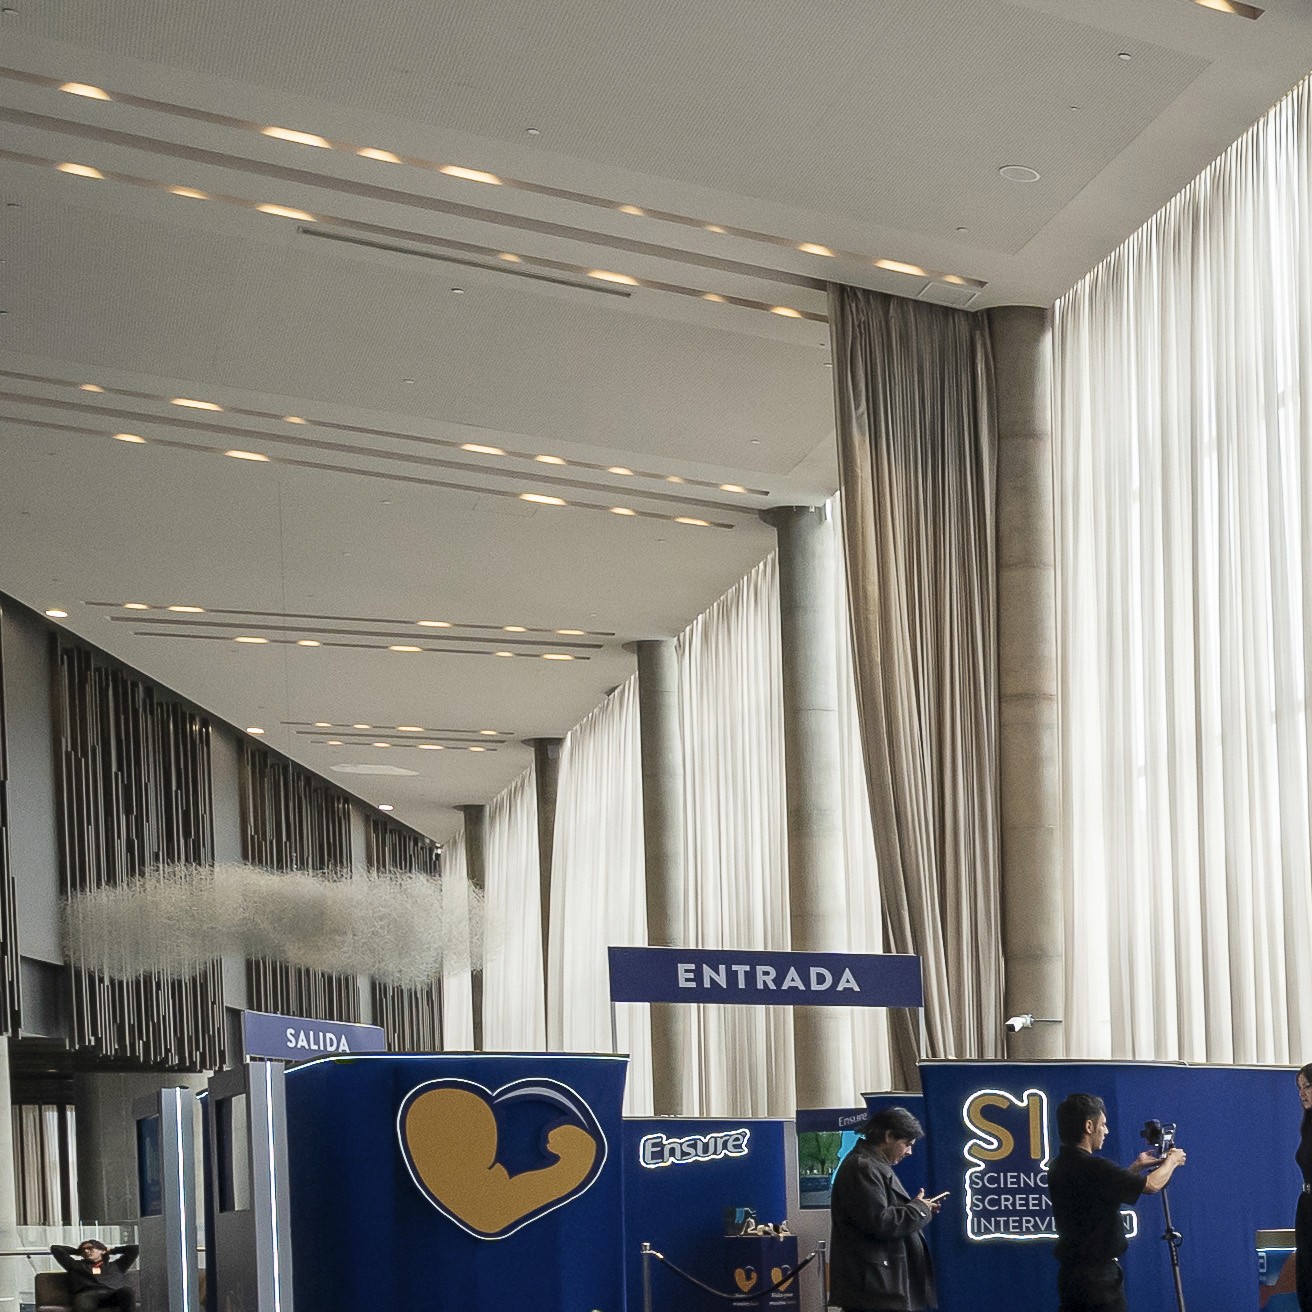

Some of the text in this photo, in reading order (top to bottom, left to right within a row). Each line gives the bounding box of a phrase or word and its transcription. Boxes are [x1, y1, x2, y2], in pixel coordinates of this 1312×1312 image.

[677, 963, 861, 992] ENTRADA
[286, 1028, 350, 1053] SALIDA
[970, 1095, 1042, 1161] SI
[643, 1131, 746, 1164] Ensure
[972, 1172, 1049, 1189] SCIENC
[972, 1195, 1053, 1211] SCREEN
